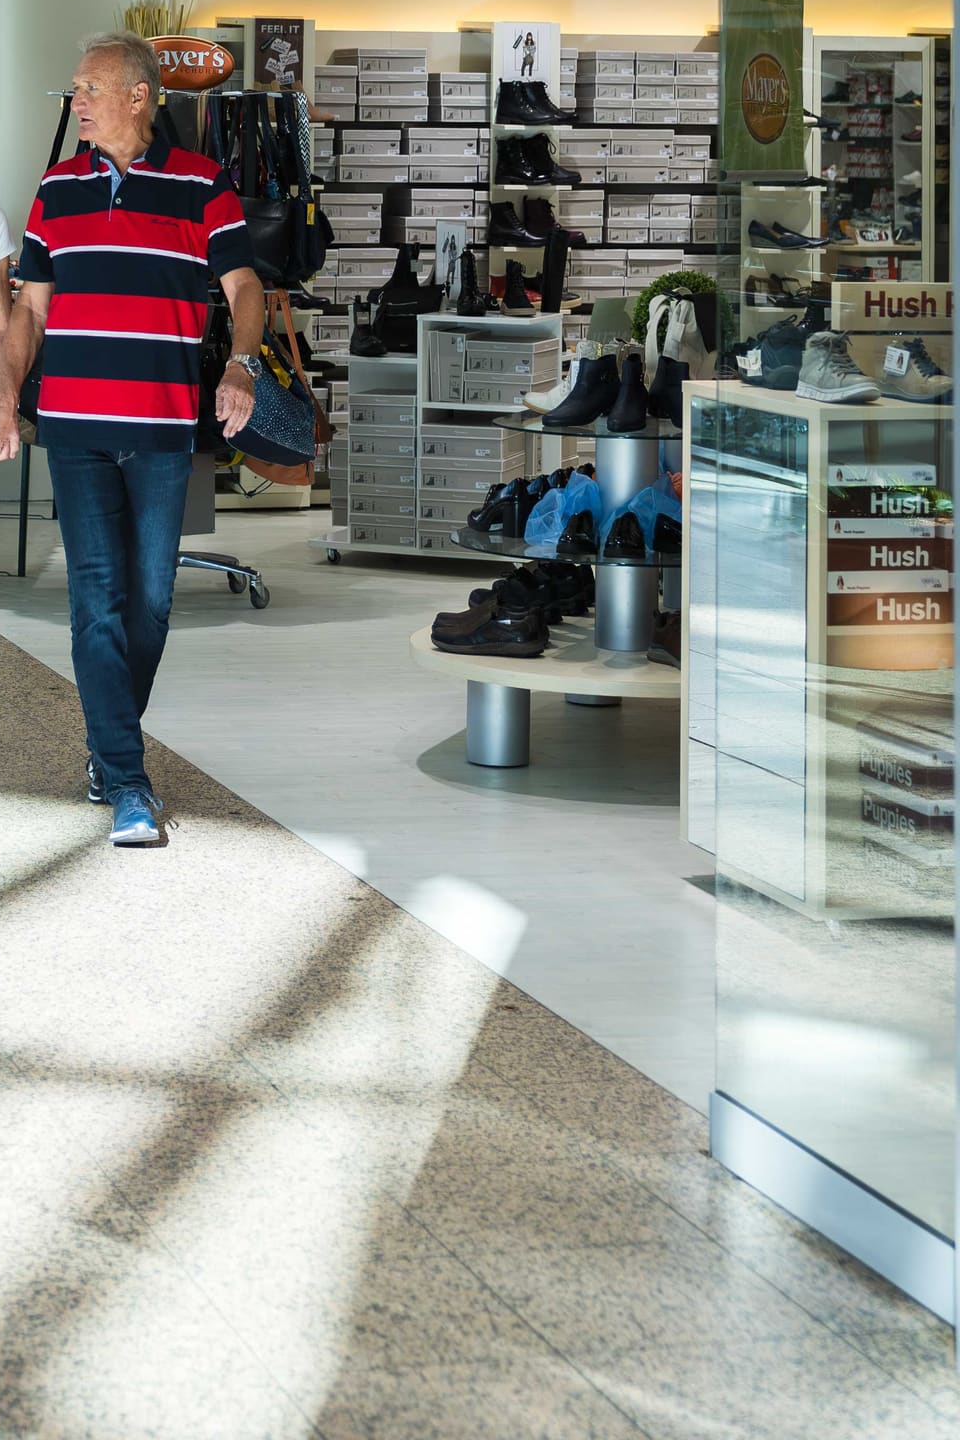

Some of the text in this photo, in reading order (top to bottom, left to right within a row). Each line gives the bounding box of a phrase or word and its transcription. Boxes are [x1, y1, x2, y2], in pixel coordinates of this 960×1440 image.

[261, 25, 300, 34] FEEL IT
[152, 44, 225, 73] ayer's
[864, 290, 937, 318] Hush
[870, 492, 930, 514] Hush
[870, 546, 929, 567] Hush
[877, 598, 940, 621] Hush
[863, 795, 916, 834] Puppies
